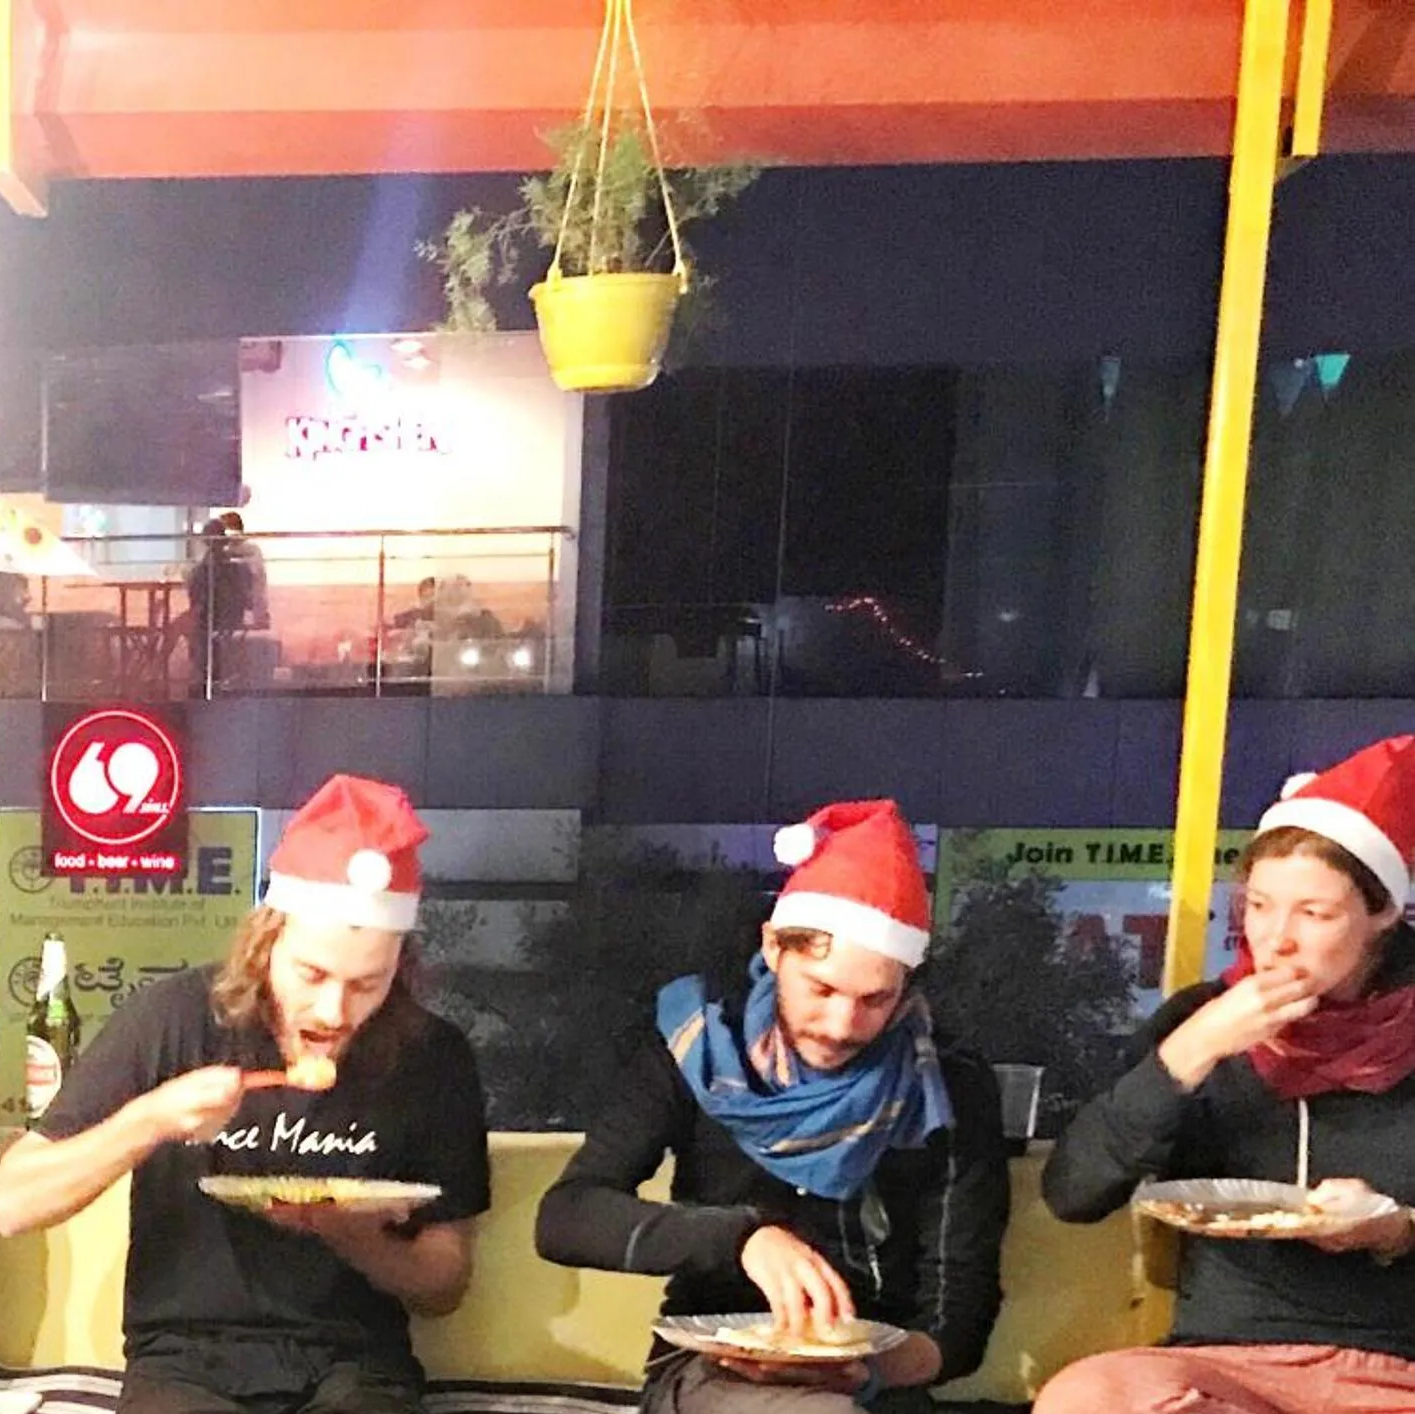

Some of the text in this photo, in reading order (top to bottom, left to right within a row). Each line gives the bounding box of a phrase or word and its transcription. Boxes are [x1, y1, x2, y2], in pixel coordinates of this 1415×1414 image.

[68, 741, 161, 815] 69
[54, 851, 176, 869] food beer wine
[1006, 841, 1074, 864] Join
[270, 1112, 378, 1155] Mania
